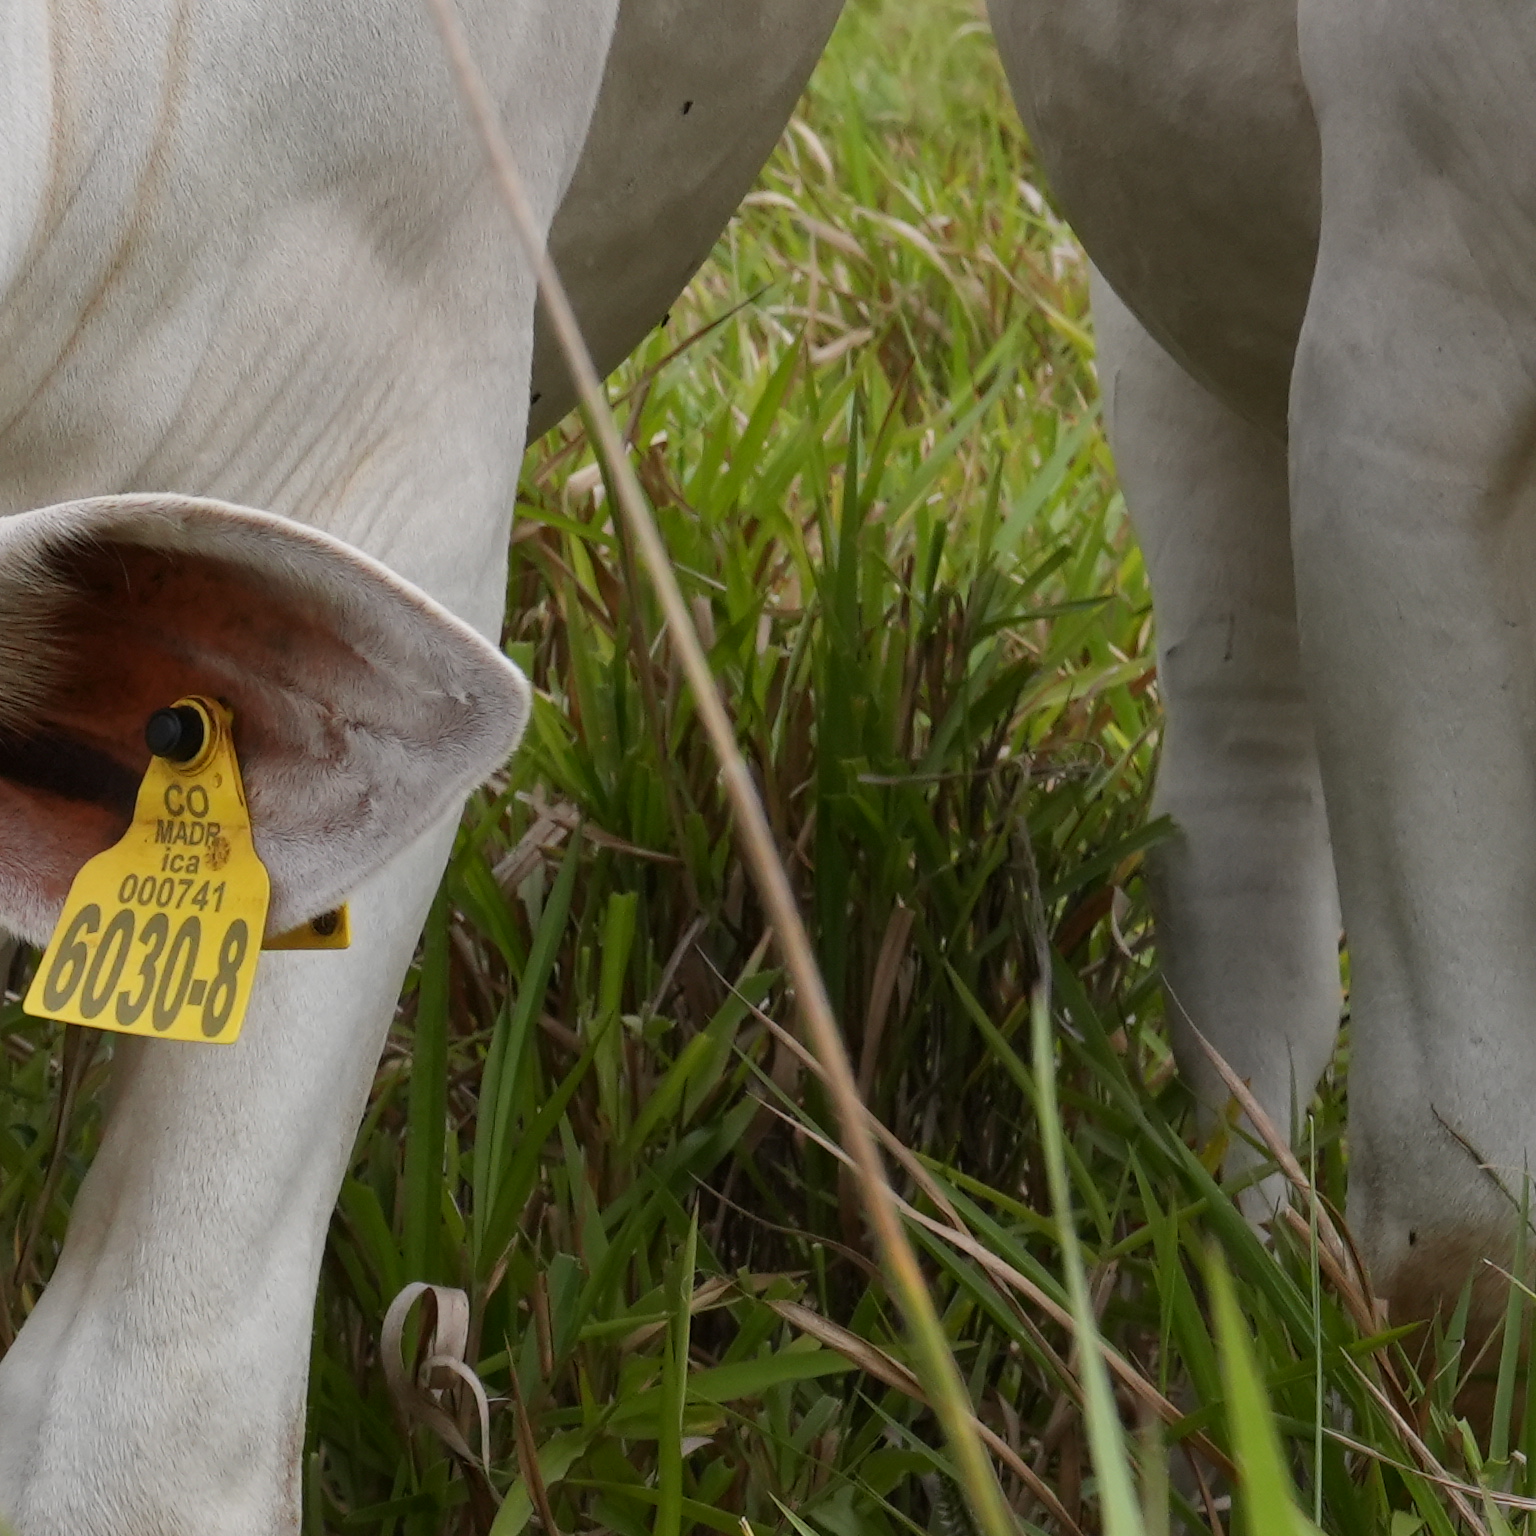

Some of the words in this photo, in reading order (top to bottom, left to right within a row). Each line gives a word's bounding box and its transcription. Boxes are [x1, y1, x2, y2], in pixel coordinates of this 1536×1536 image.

[163, 784, 209, 818] CO
[154, 819, 221, 847] MADR
[161, 847, 200, 874] ica
[117, 873, 227, 913] 000741
[42, 903, 249, 1038] 6030-8
